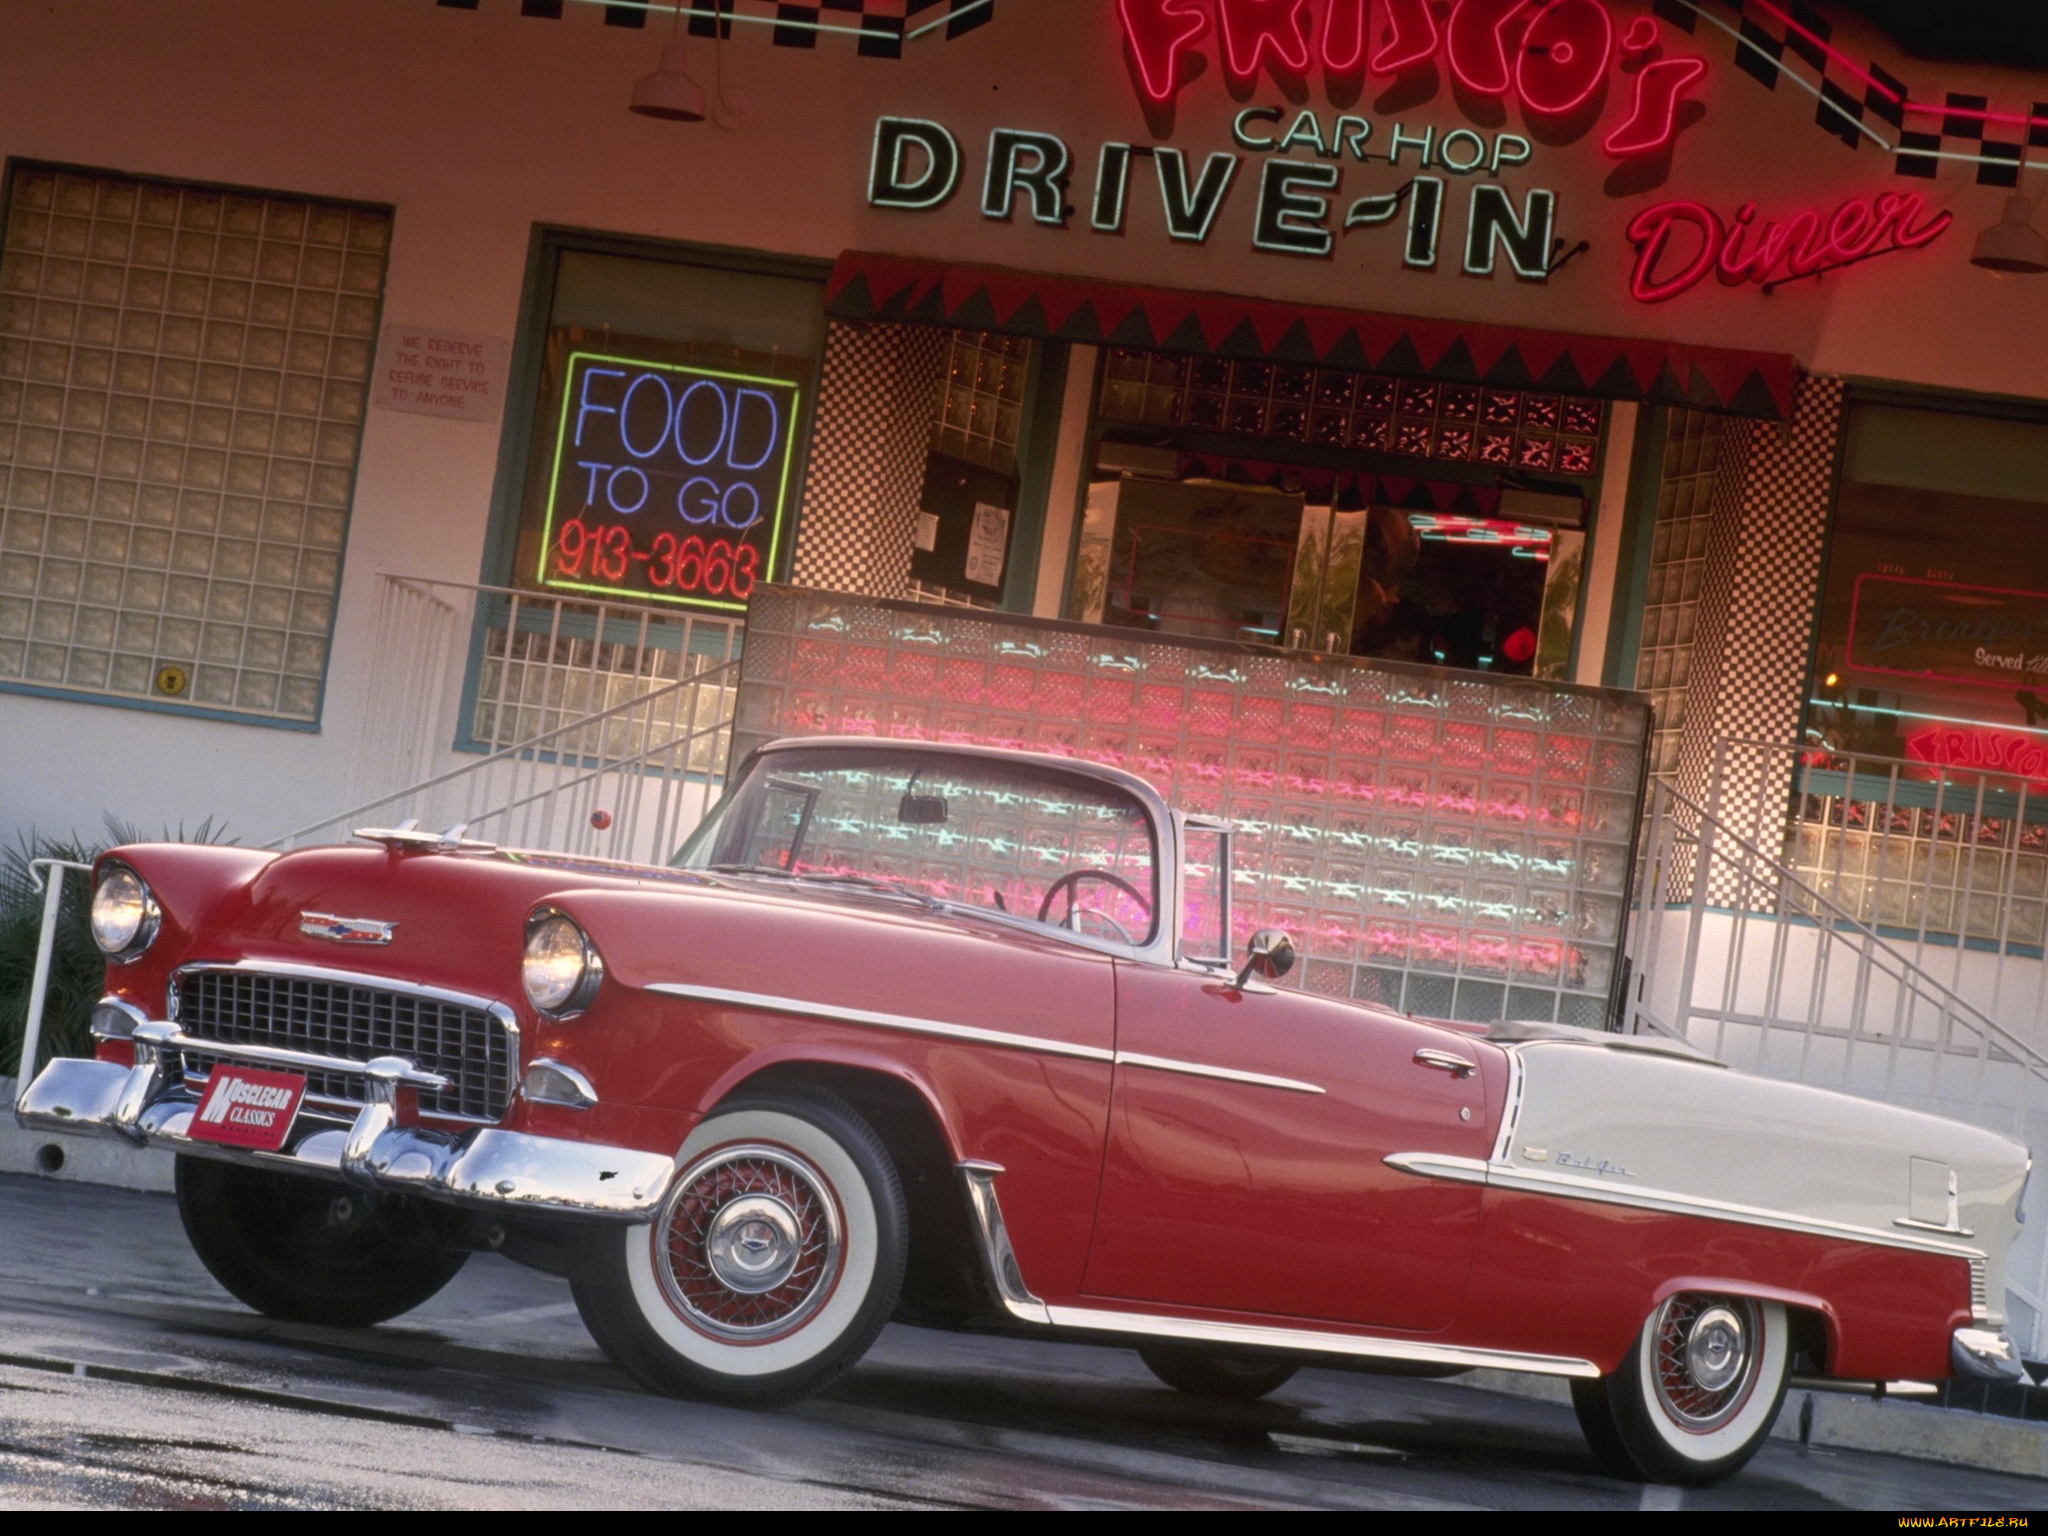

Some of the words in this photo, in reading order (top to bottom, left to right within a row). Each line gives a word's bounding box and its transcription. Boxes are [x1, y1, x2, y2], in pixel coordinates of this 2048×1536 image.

[1233, 106, 1371, 160] CAR
[1389, 122, 1533, 175] HOP
[866, 115, 1558, 280] DRIVE-IN
[1626, 191, 1953, 303] Diner
[396, 352, 419, 367] THE
[426, 355, 463, 372] RIGHT
[468, 361, 485, 375] TO
[402, 334, 421, 349] WE
[427, 337, 484, 357] RESERVE
[388, 369, 434, 387] REFUSE
[441, 374, 492, 394] SERVICE
[391, 387, 408, 400] TO
[574, 366, 778, 471] FOOD
[576, 460, 650, 515] TO
[677, 475, 761, 530] GO
[556, 517, 761, 600] 913-3663
[1974, 646, 2024, 671] Served
[200, 1075, 293, 1124] MUSCLECAR
[229, 1106, 276, 1127] CLASSICS
